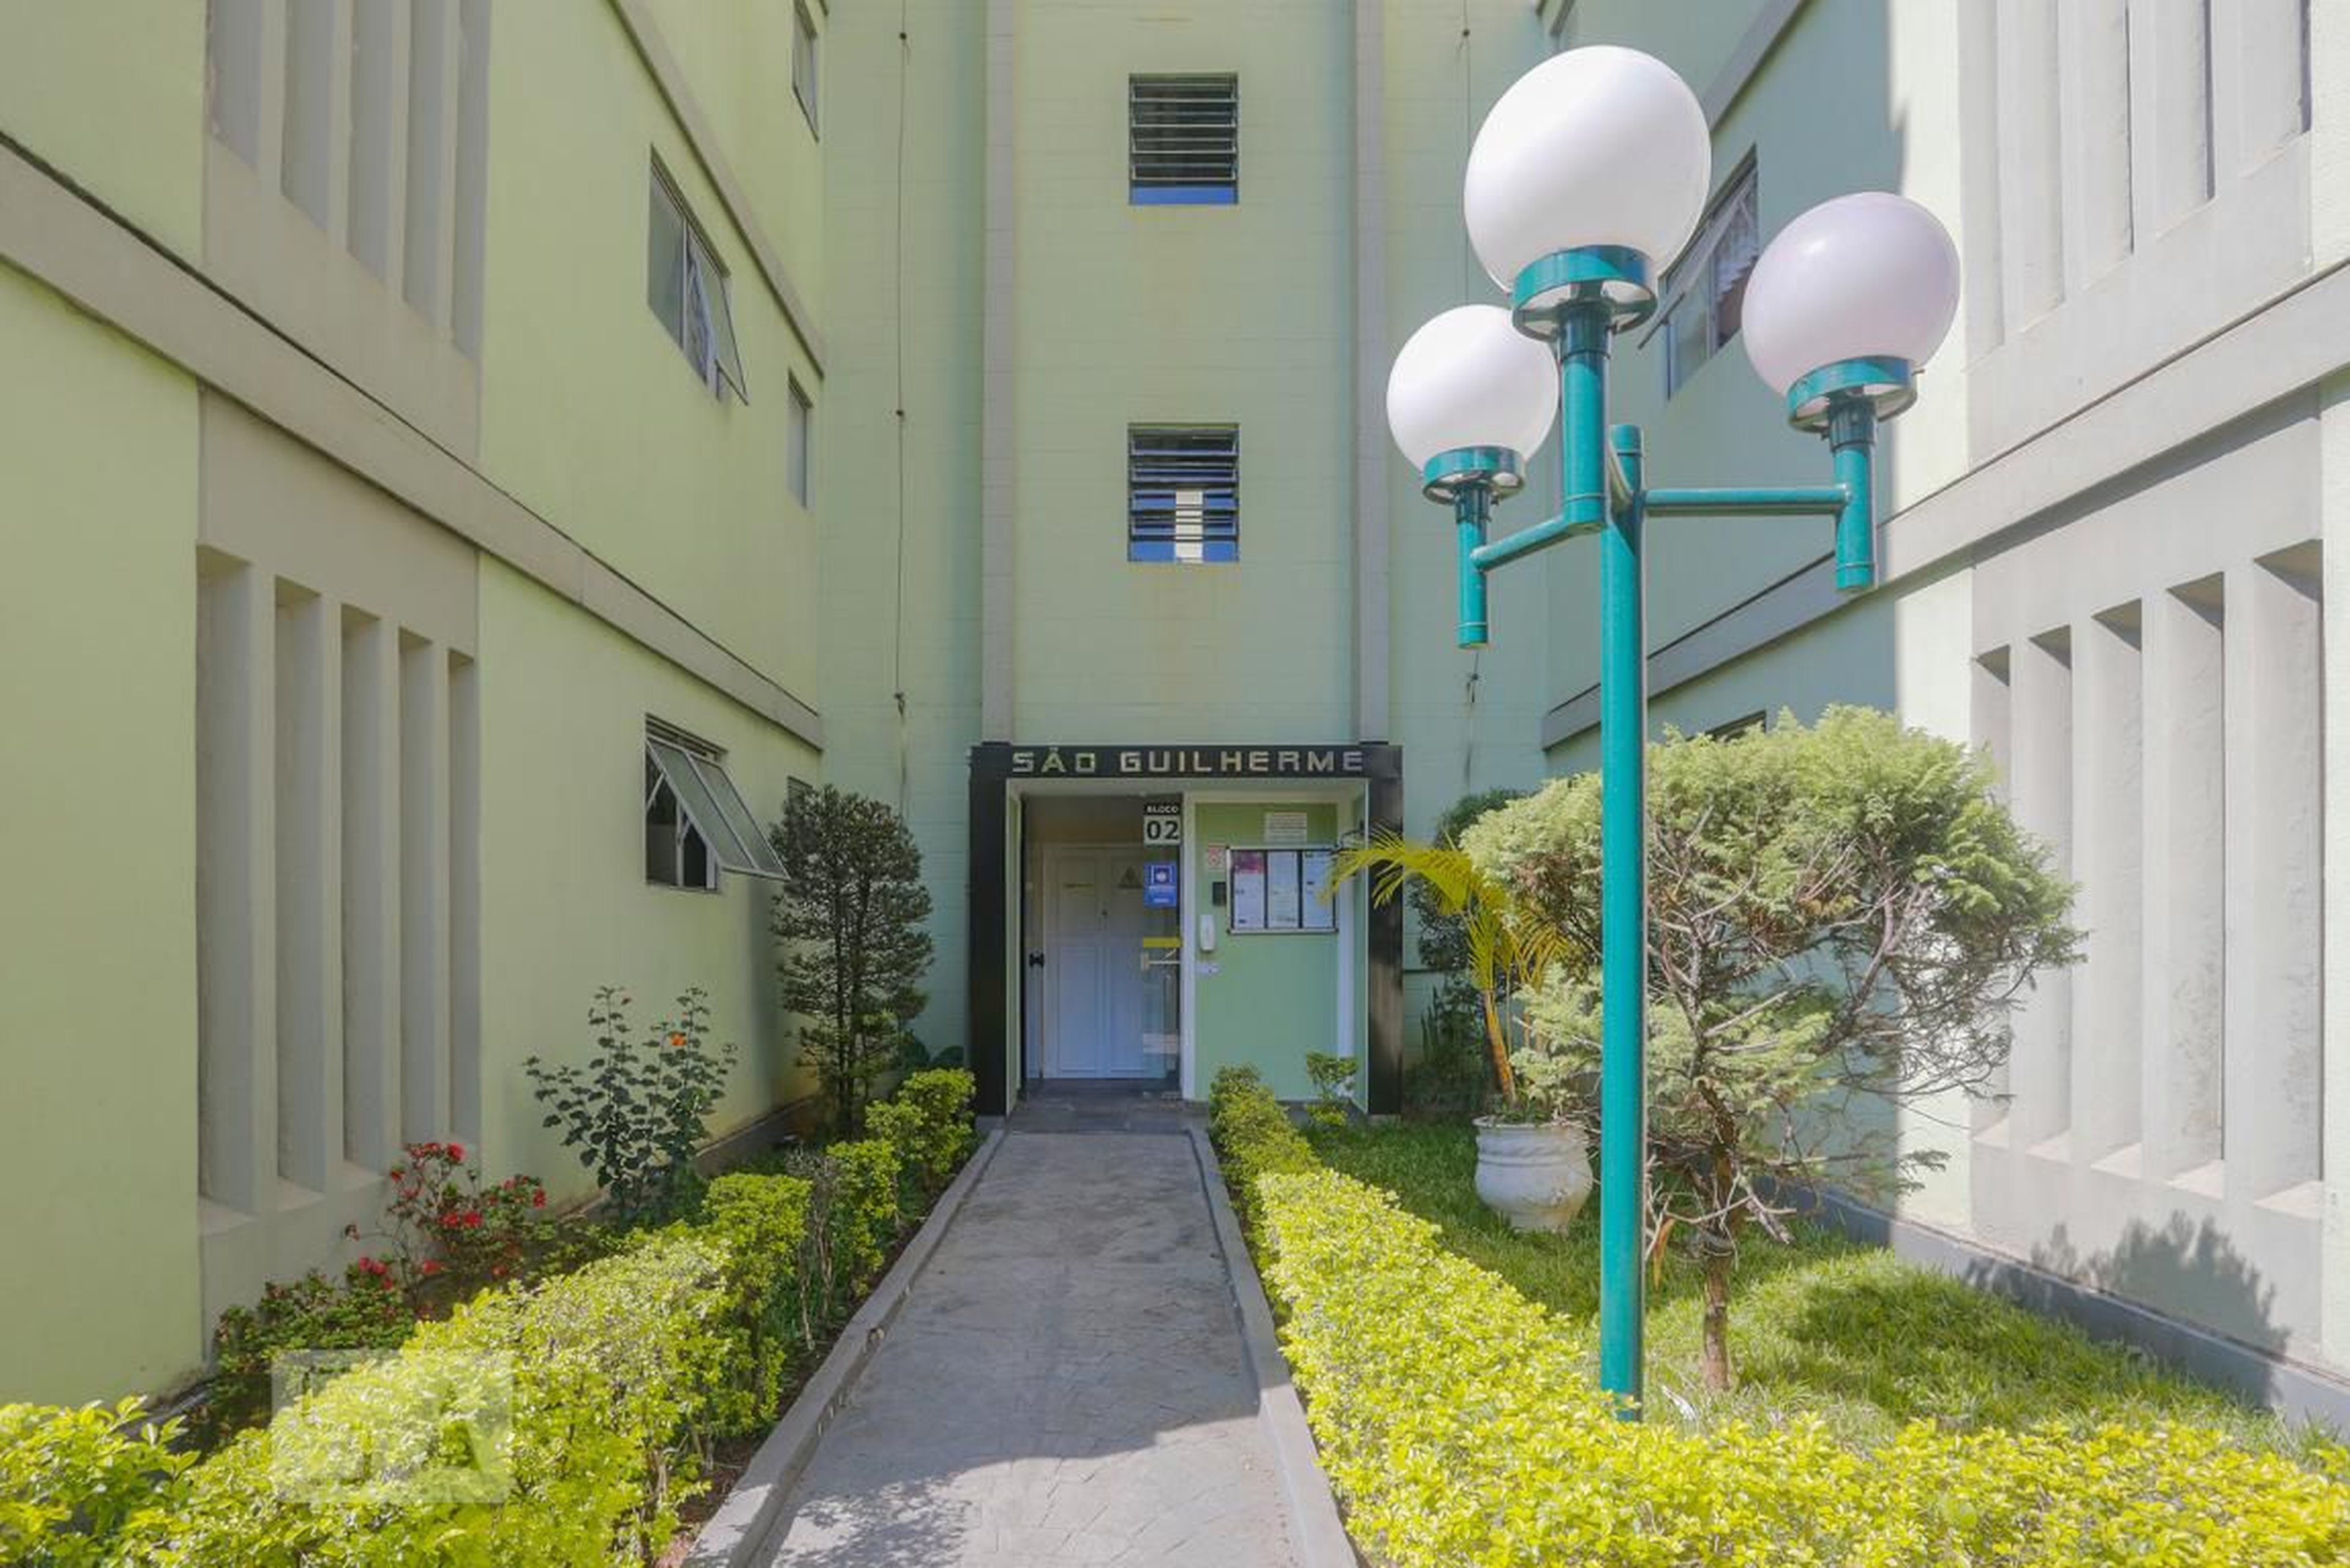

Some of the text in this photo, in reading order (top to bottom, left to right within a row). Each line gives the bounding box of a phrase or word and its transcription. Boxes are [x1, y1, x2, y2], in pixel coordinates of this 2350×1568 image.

[1012, 746, 1363, 773] SÃO GUILHERME
[1147, 821, 1179, 840] 02
